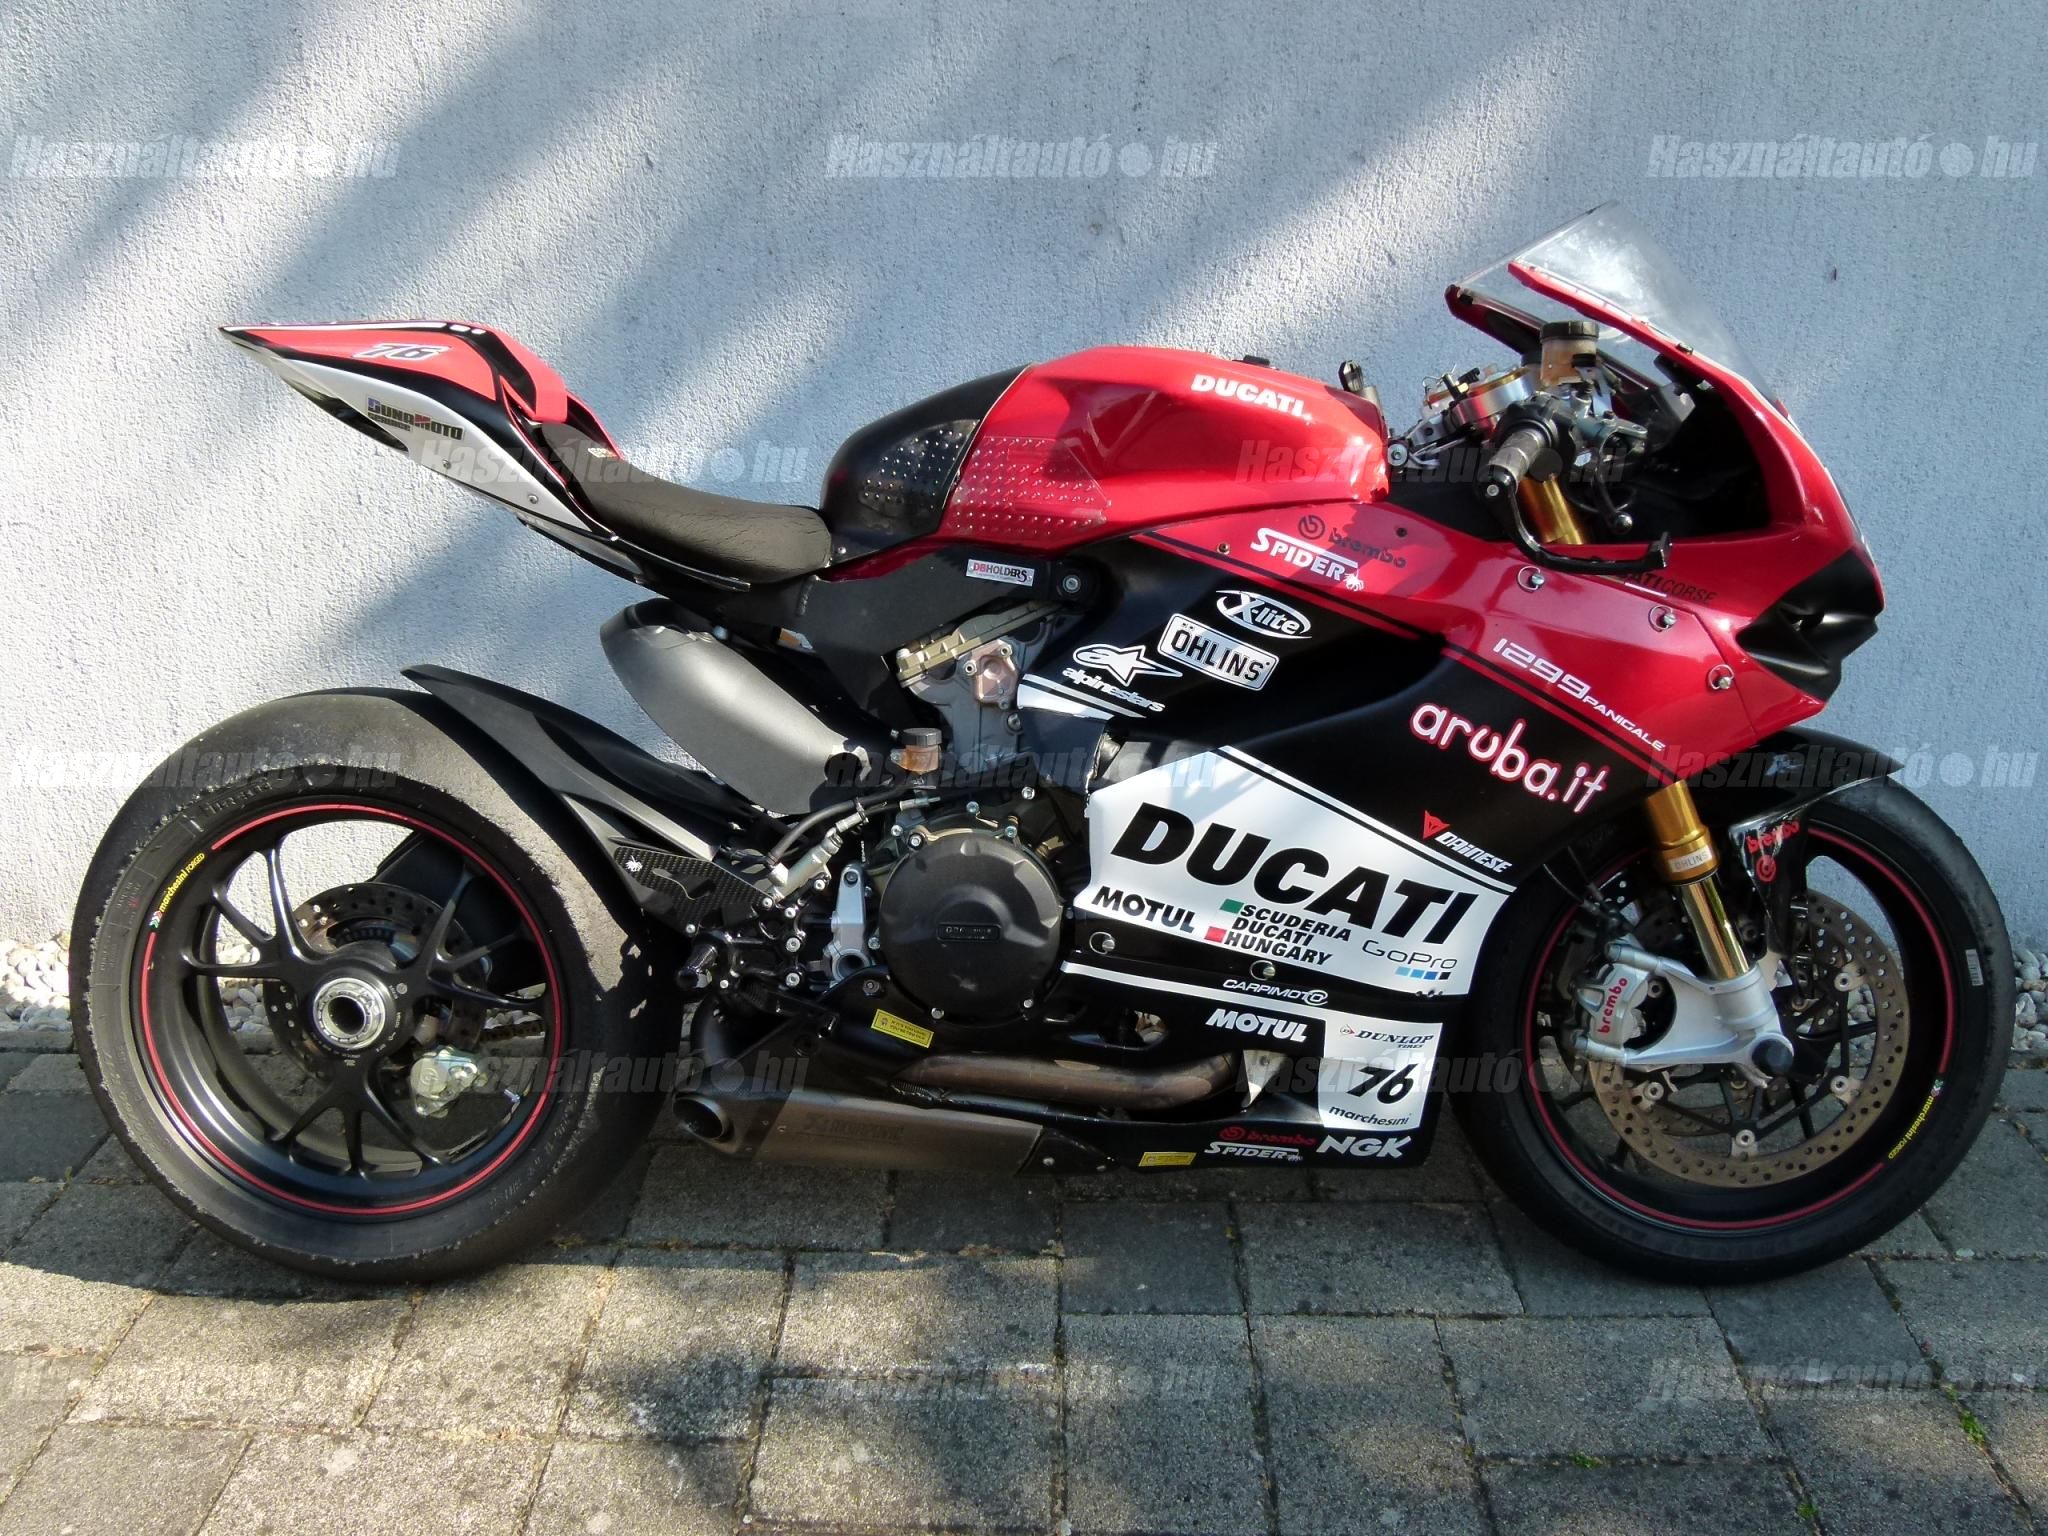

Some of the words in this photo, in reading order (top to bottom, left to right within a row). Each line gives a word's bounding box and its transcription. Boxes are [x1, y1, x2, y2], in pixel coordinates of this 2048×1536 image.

[353, 342, 451, 361] 76
[1191, 373, 1306, 418] DUCATI
[1250, 527, 1358, 582] SPIDER
[1328, 528, 1407, 568] brembo
[1224, 590, 1301, 635] X-lite
[1171, 622, 1264, 681] ÖHLINS
[1062, 667, 1166, 712] alpinestars
[1493, 638, 1591, 700] 1299
[1582, 695, 1666, 752] PANIGALE
[1410, 702, 1610, 814] aruba.it
[159, 869, 189, 912] marchesini
[1110, 801, 1480, 945] DUCATI
[1091, 885, 1196, 934] MOTUL
[1239, 904, 1352, 942] SCUDERIA
[1223, 932, 1333, 966] HUNGARY
[1231, 917, 1315, 946] DUCATI
[1363, 938, 1458, 970] GoPro
[1206, 1008, 1308, 1043] MOTUL
[1598, 977, 1629, 1034] brembo
[1355, 1030, 1434, 1044] DUNLOP
[1346, 1063, 1419, 1104] 76
[1329, 1106, 1410, 1126] marchesini
[1204, 1141, 1299, 1160] SPIDER
[1247, 1130, 1318, 1146] brembo
[1316, 1134, 1412, 1159] NGK
